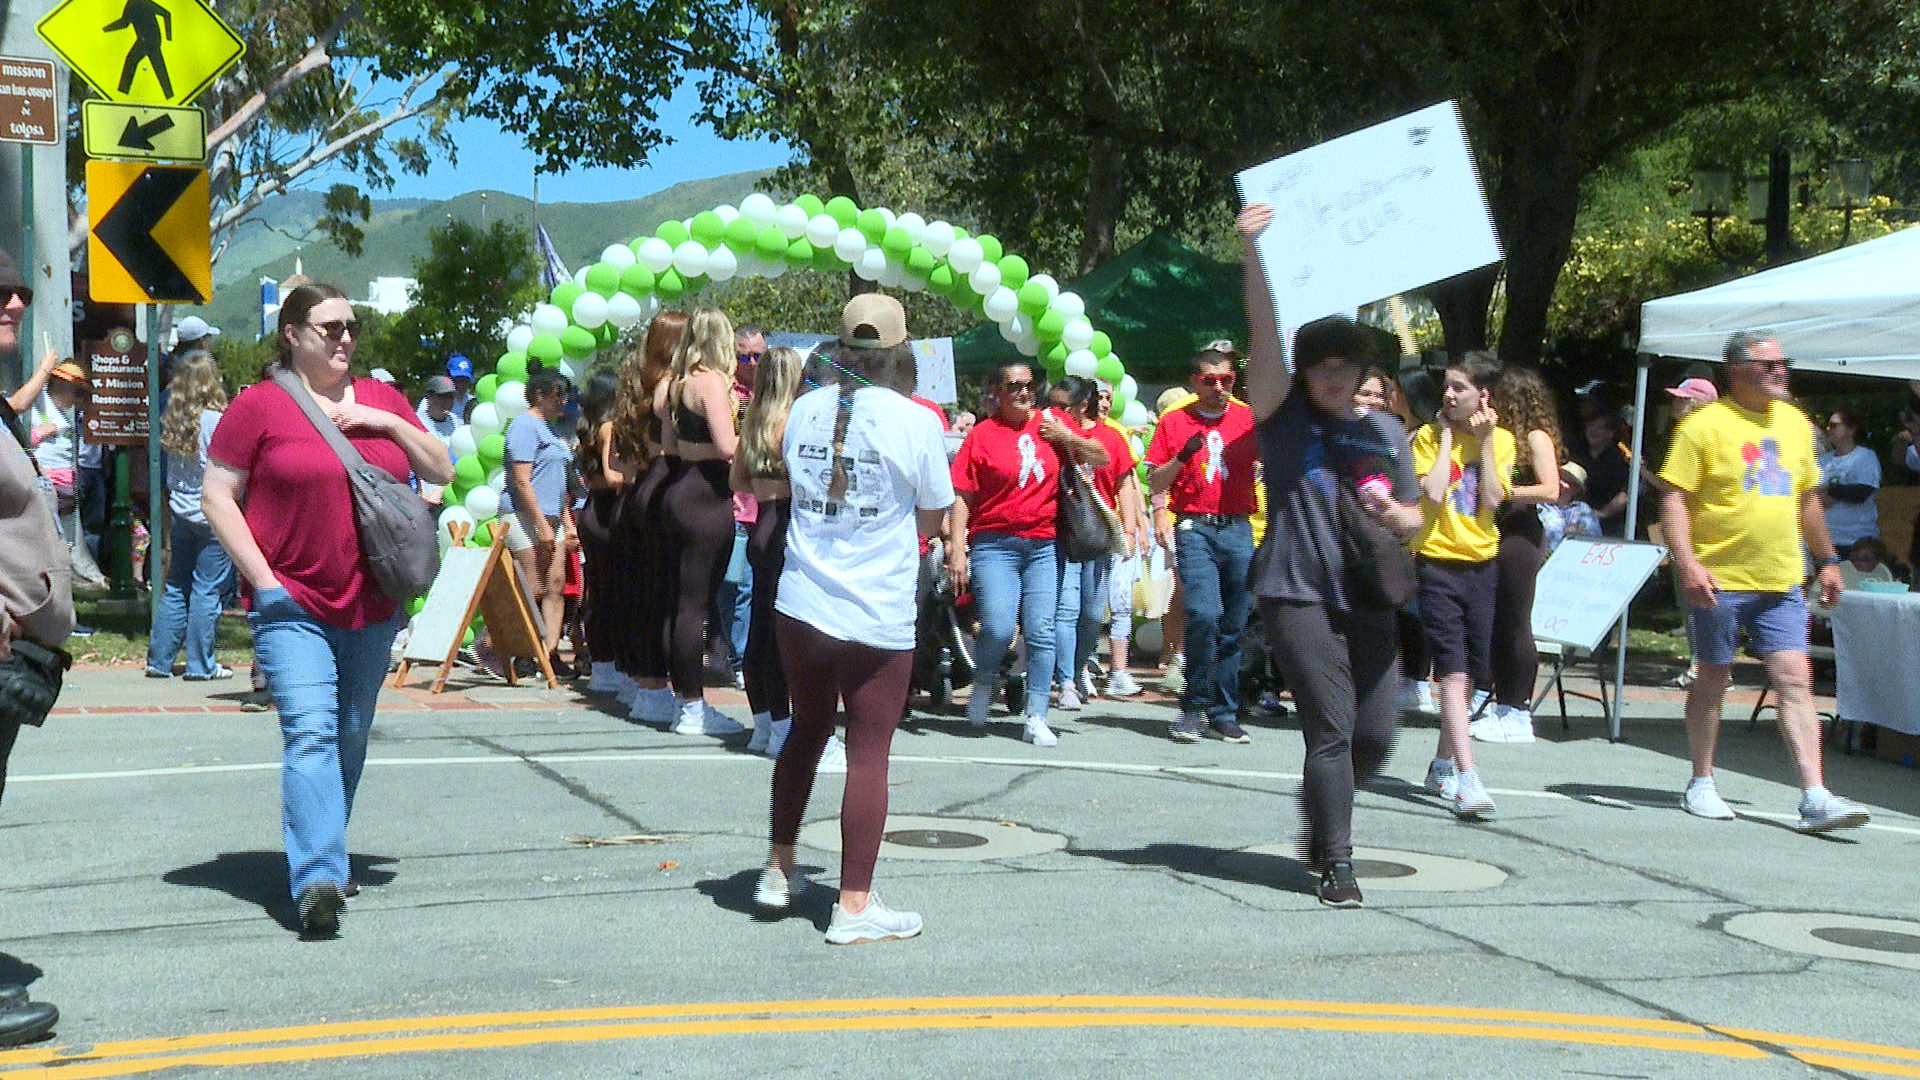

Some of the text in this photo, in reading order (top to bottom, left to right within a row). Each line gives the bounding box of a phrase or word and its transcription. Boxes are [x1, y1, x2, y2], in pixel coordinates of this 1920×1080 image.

[2, 64, 46, 79] mission
[10, 122, 45, 136] tolosa
[91, 354, 130, 365] Shops &
[91, 363, 145, 373] Restaurants
[105, 378, 144, 388] Mission
[92, 394, 141, 404] Restrooms
[1581, 542, 1623, 566] EAS
